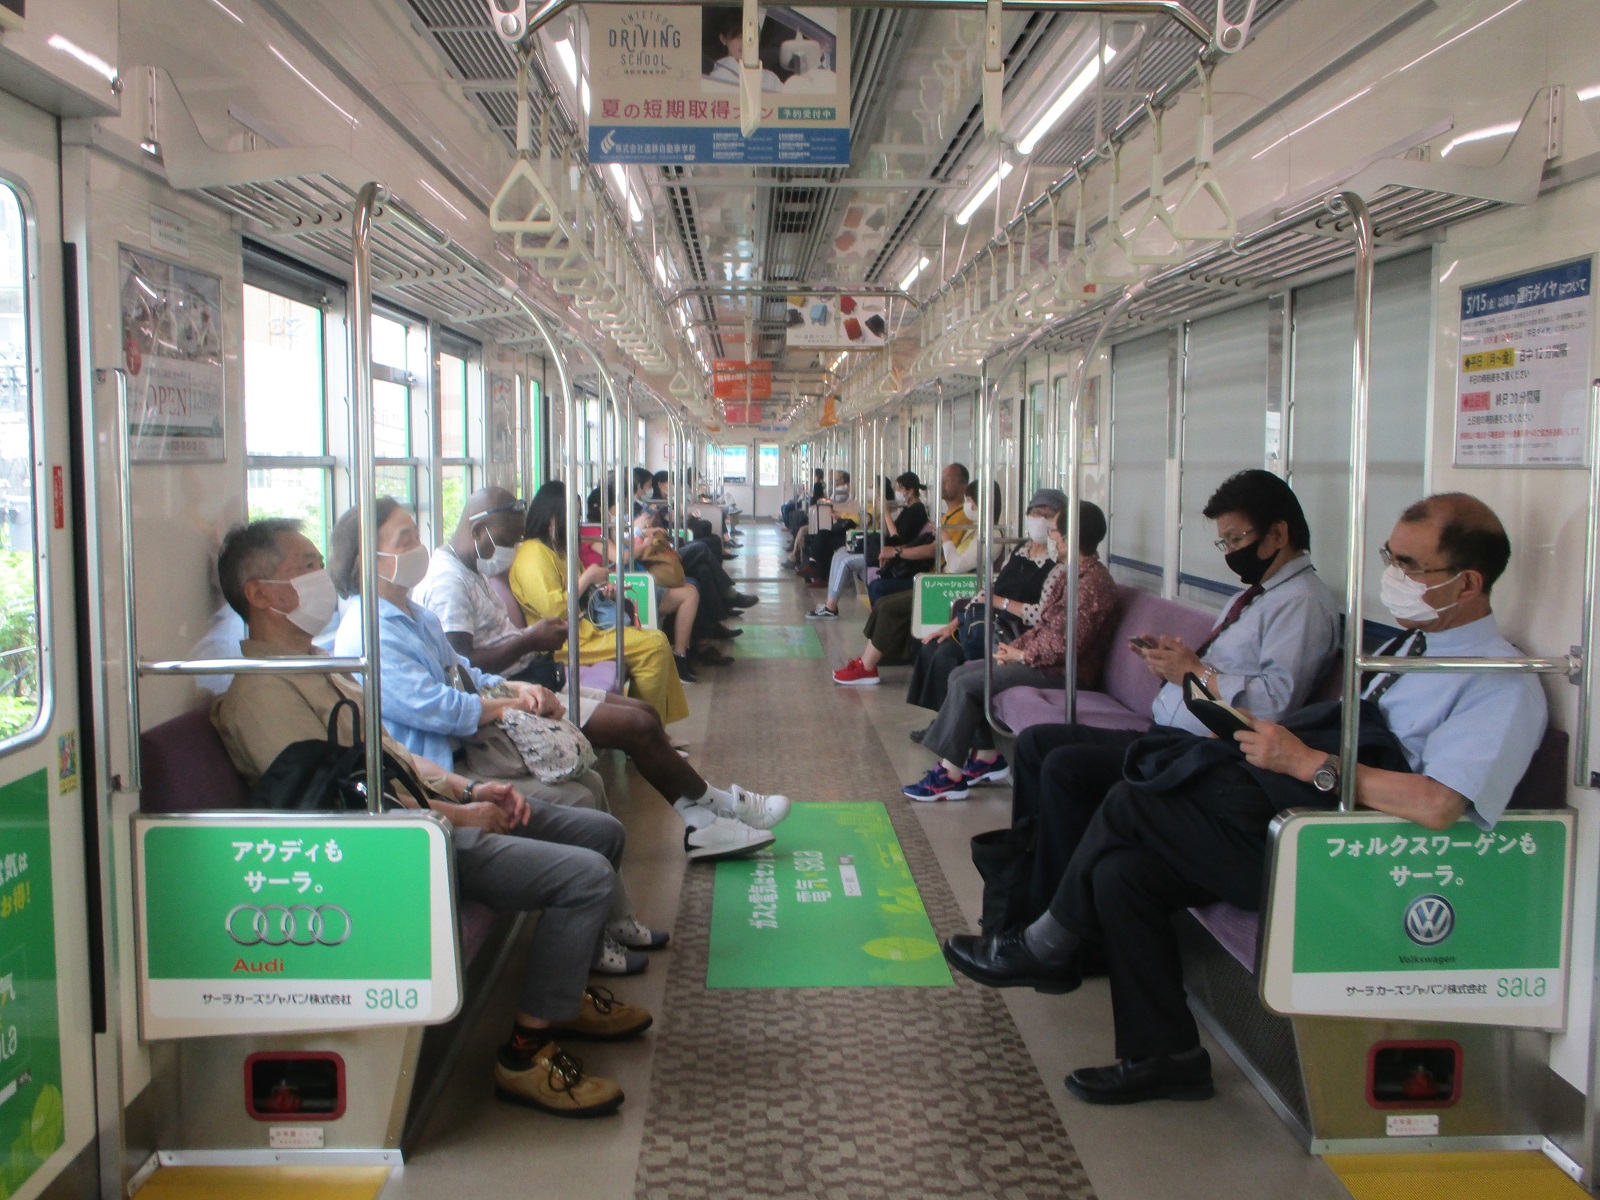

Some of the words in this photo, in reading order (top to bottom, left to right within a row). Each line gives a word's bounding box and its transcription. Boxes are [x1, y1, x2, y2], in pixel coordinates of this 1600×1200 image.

[609, 24, 681, 52] DRIVING
[621, 52, 672, 69] SCHOOL
[602, 99, 773, 120] 夏の短期取得ン
[232, 839, 343, 863] アウディも
[1327, 832, 1537, 857] フォルクスワーゲンも
[0, 852, 28, 886] 気は
[1389, 865, 1464, 887] サーラ。
[244, 870, 323, 893] サーラ。
[232, 958, 285, 973] Audi
[1399, 955, 1456, 965] Volkswagen
